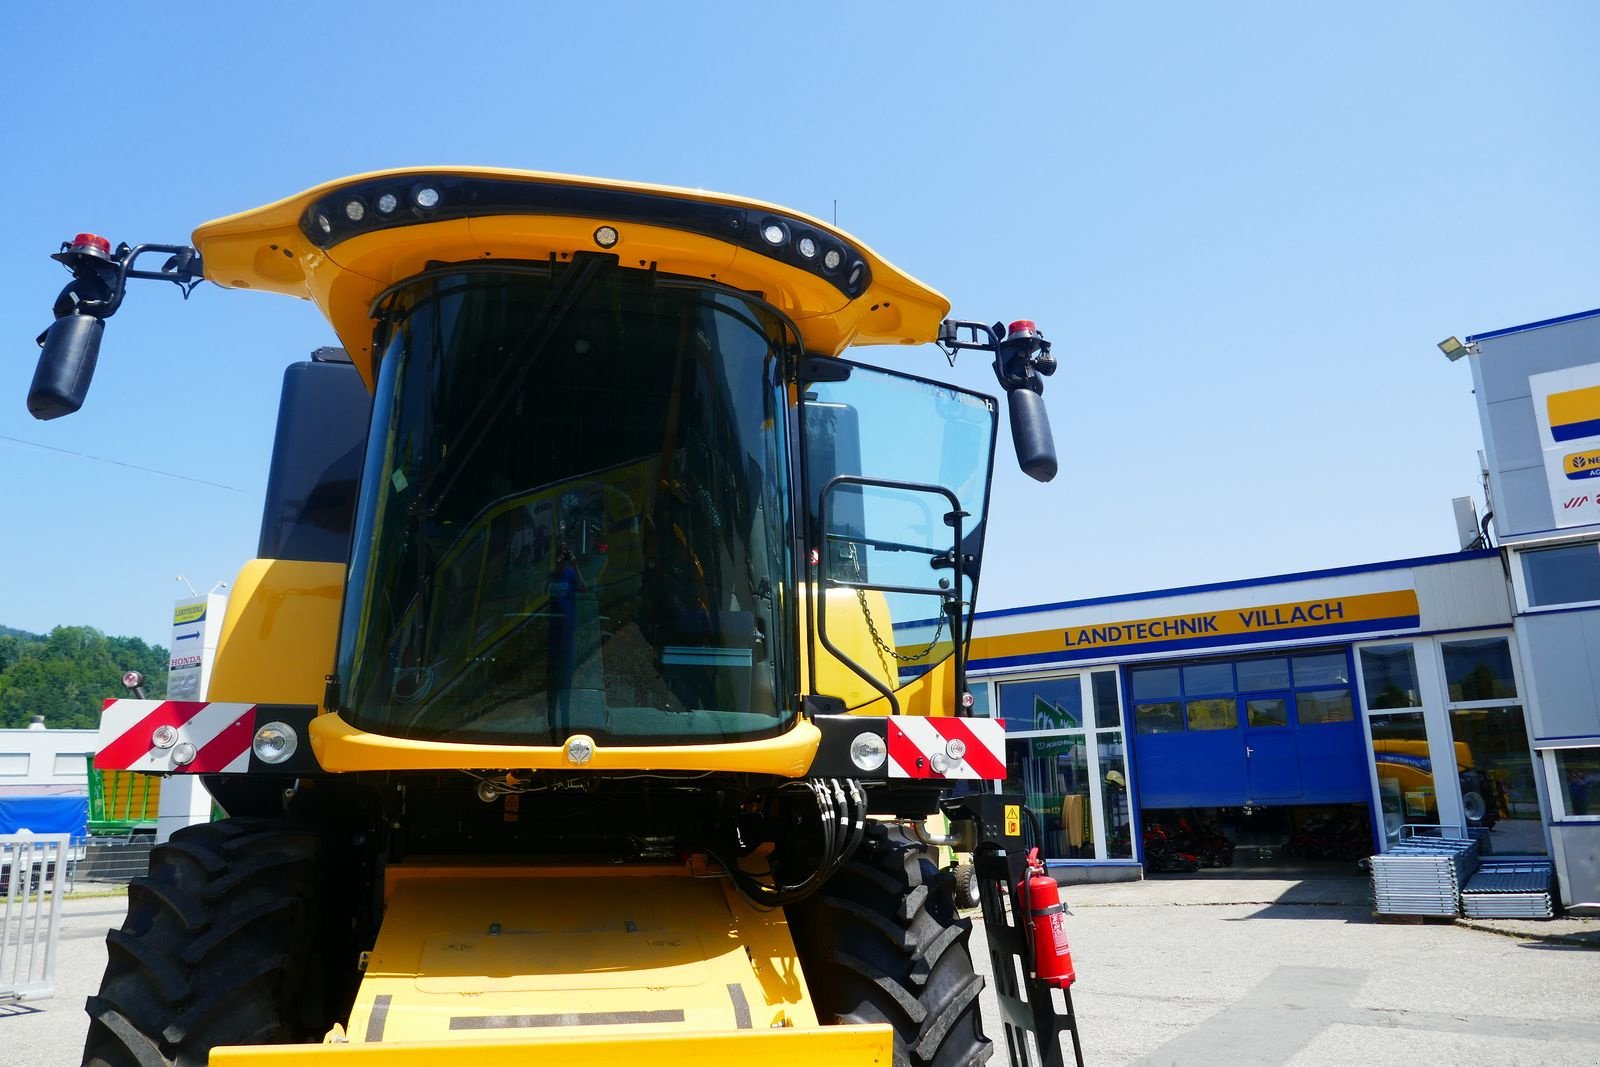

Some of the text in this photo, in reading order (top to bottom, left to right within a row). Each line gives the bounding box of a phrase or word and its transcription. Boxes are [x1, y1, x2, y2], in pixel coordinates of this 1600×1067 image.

[1064, 601, 1344, 647] LANDTECHNIK VILLACH
[171, 655, 202, 666] HONDA
